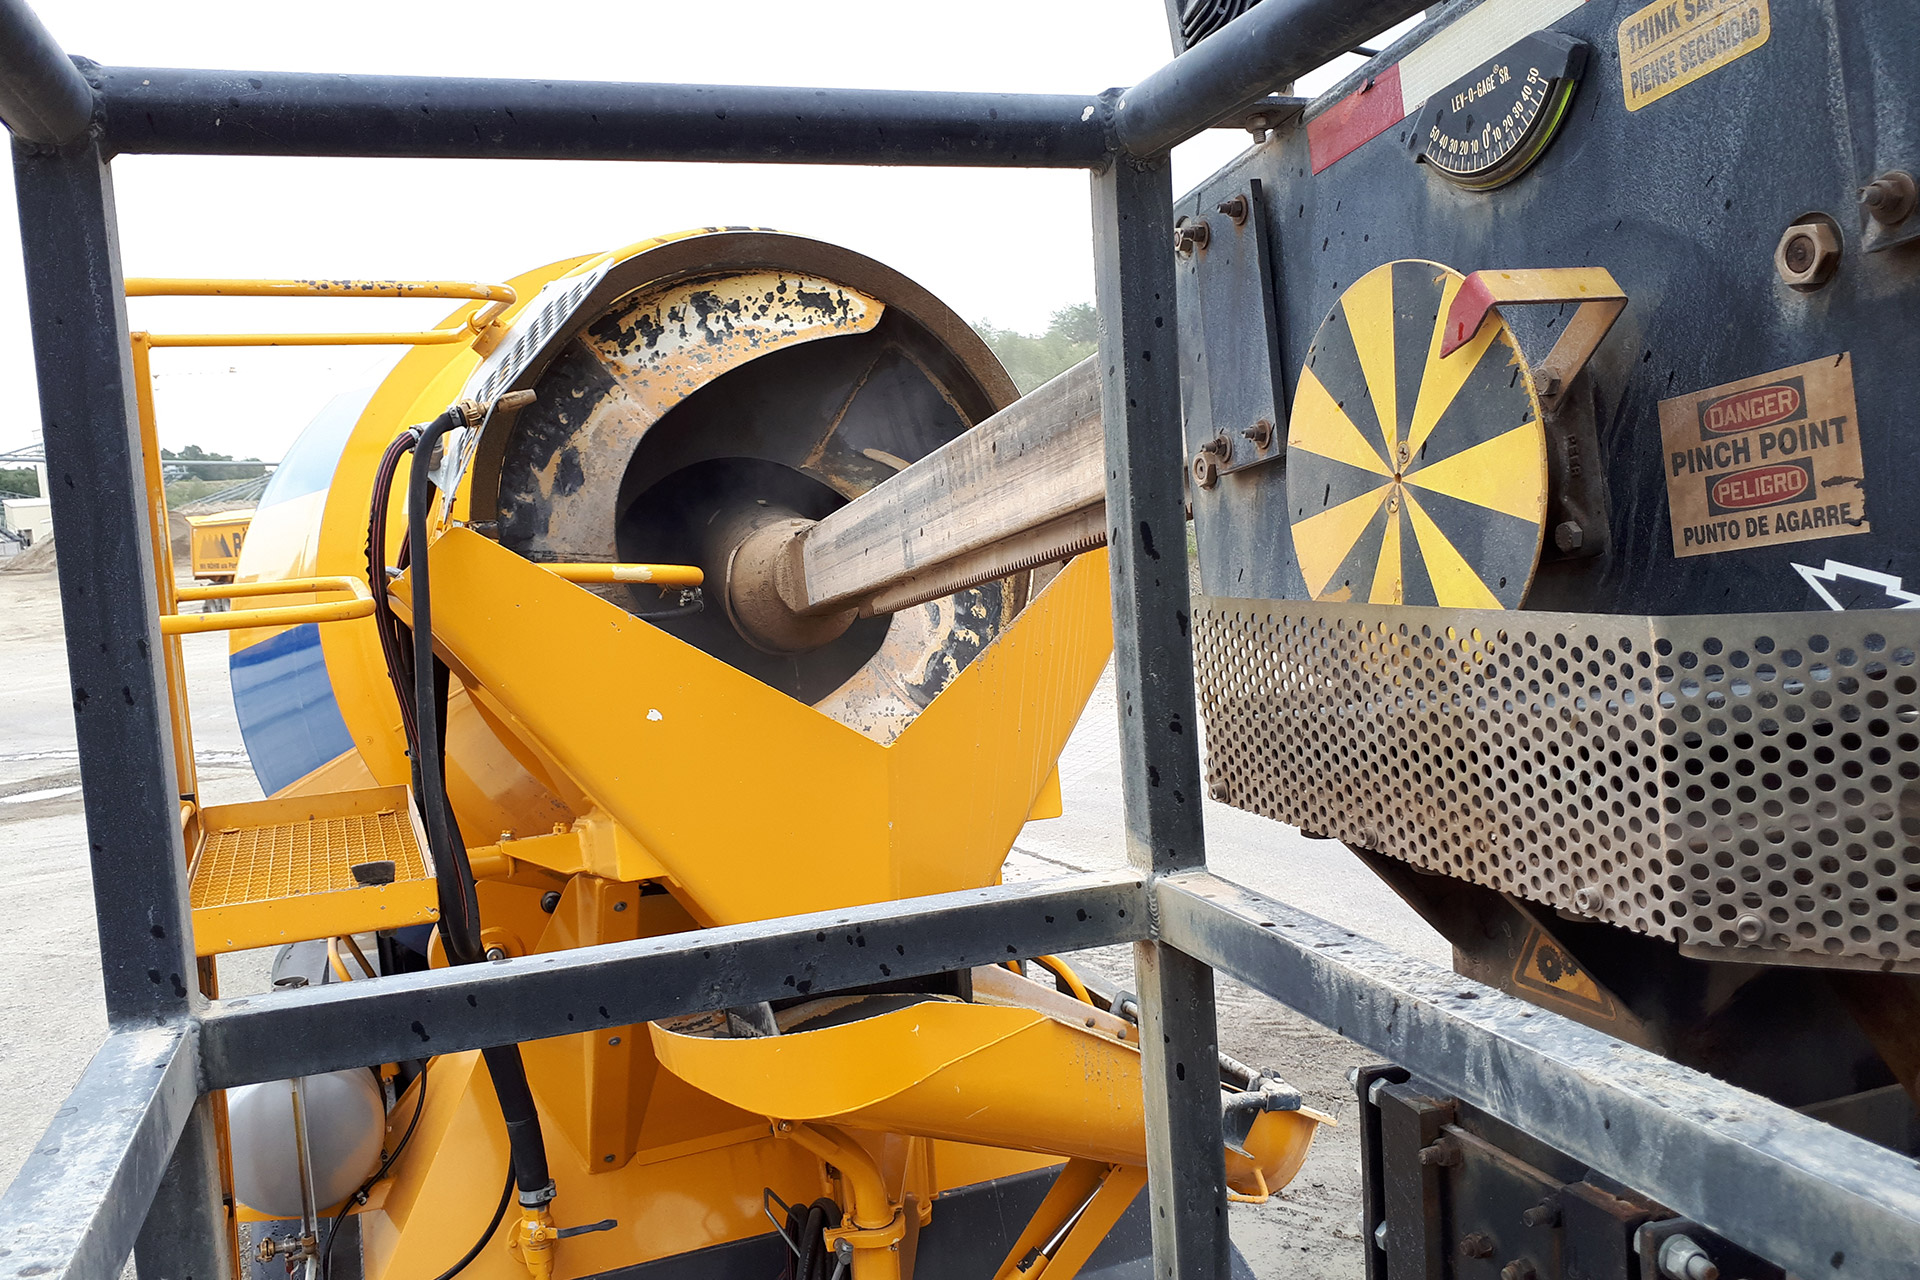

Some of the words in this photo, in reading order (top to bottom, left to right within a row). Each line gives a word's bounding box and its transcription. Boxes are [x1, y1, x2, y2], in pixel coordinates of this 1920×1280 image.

[1626, 1, 1680, 53] THINK
[1630, 50, 1677, 99] PIENSE
[1680, 7, 1761, 73] SEGURIDAD
[1429, 125, 1440, 142] 50
[1438, 133, 1449, 149] 40
[1448, 138, 1459, 154] 30
[1459, 141, 1469, 155] 20
[1470, 139, 1479, 154] 10
[1492, 126, 1502, 143] 10
[1502, 114, 1514, 133] 20
[1512, 101, 1524, 118] 30
[1521, 85, 1533, 102] 40
[1527, 67, 1540, 84] 50
[1710, 389, 1793, 429] DANGER
[1671, 437, 1751, 477] PINCH
[1759, 416, 1847, 459] POINT
[1718, 469, 1802, 504] PELIGRO
[1683, 519, 1741, 547] PUNTO
[1745, 515, 1770, 538] DE
[1775, 502, 1851, 534] AGARRE
